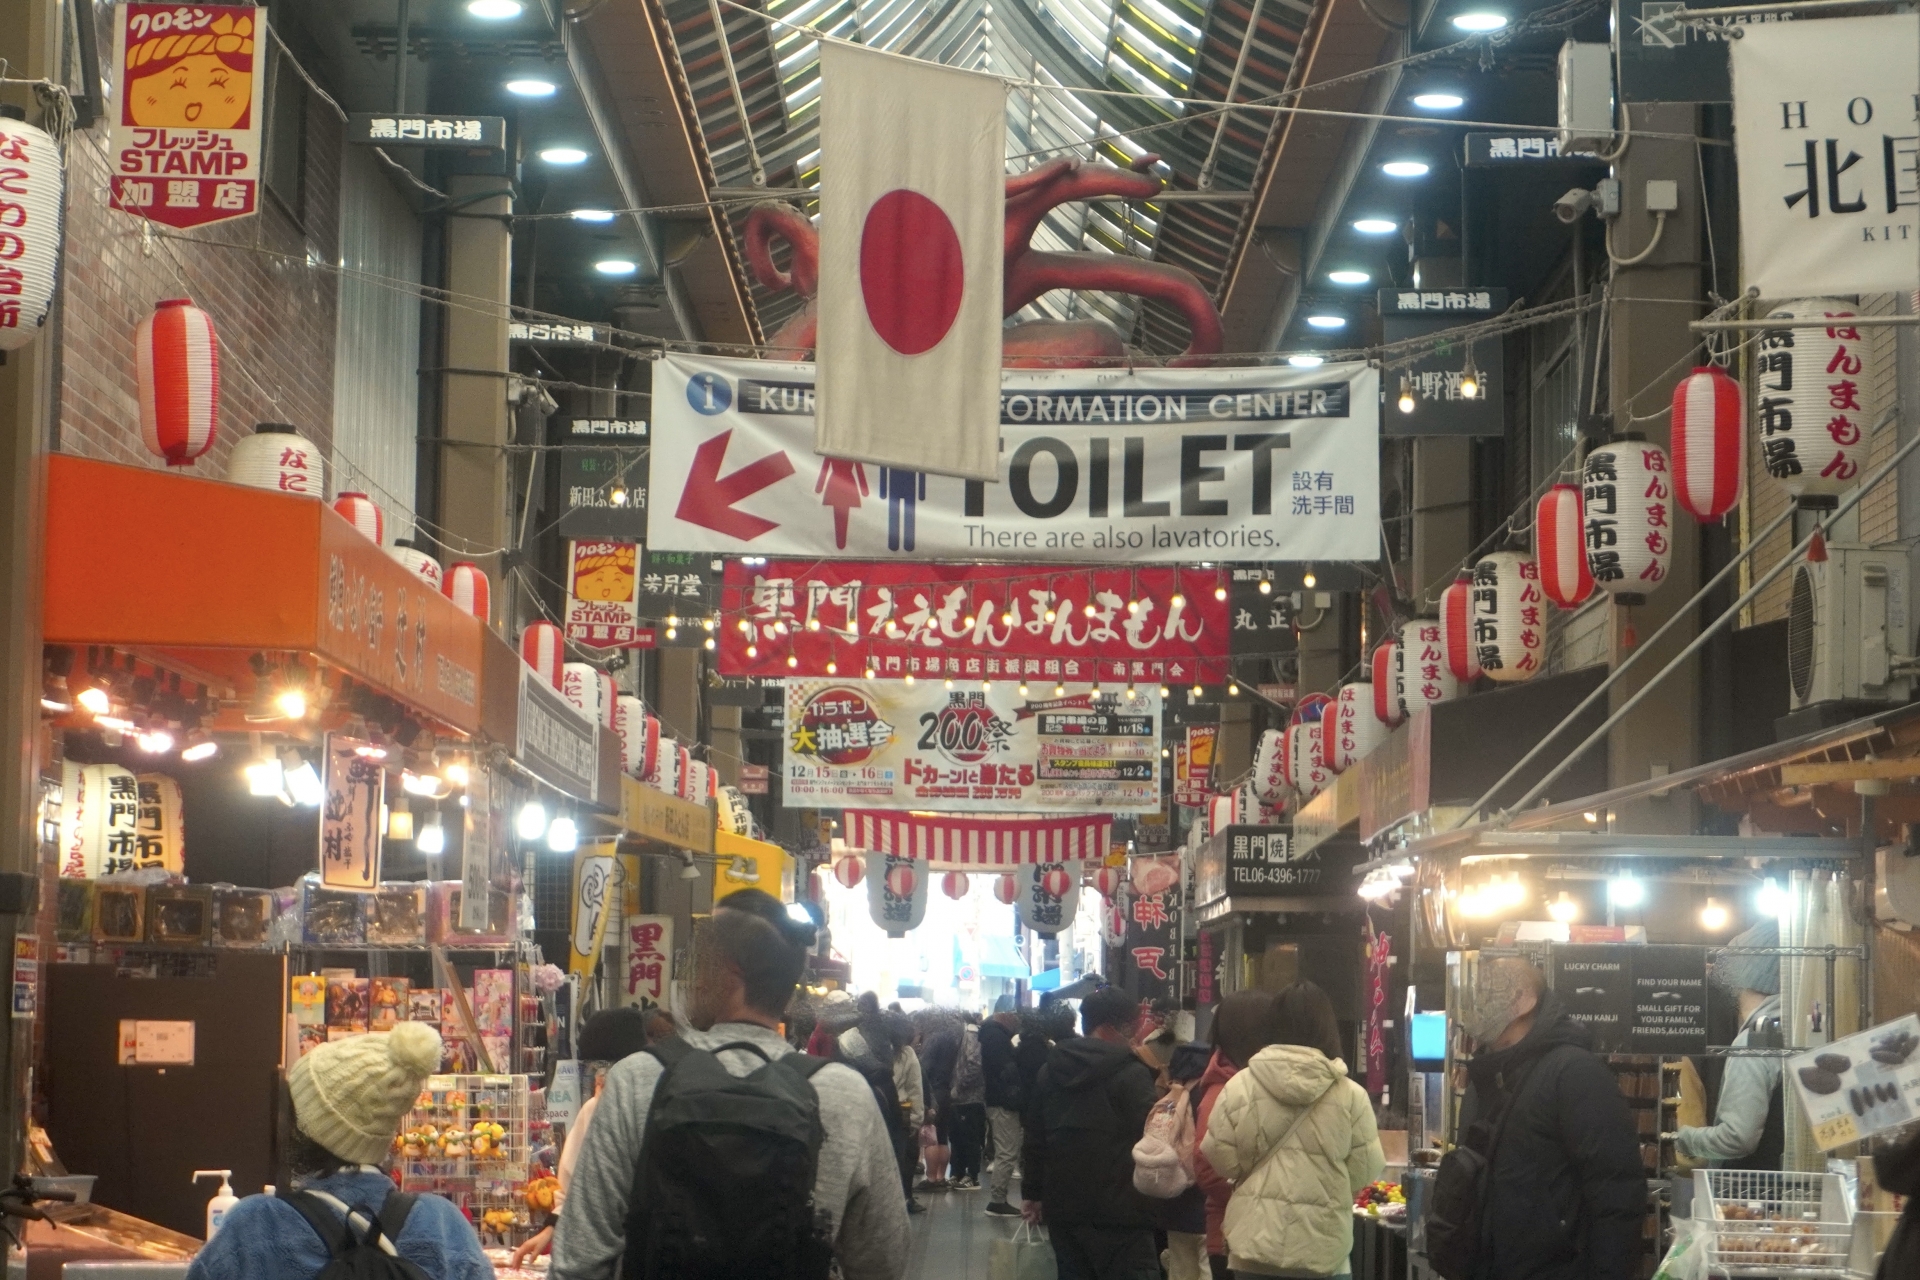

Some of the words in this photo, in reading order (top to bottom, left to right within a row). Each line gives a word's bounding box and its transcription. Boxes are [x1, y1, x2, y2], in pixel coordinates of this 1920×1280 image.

[130, 9, 213, 38] クロモン
[133, 130, 233, 150] フレッシュ
[369, 119, 482, 140] 黒門市場
[1490, 138, 1599, 158] 黒門市
[121, 151, 248, 175] STAMP
[120, 180, 247, 209] 加盟店
[1398, 292, 1491, 309] 黒門市場
[509, 324, 594, 341] 黒門市場
[1401, 371, 1488, 400] 中野酒店
[1757, 312, 1801, 479] 黒門市場
[1821, 312, 1862, 480] ほんまもん
[1001, 395, 1187, 422] ORMATION
[1209, 389, 1328, 418] CENTER
[572, 420, 647, 434] 黒門市場
[1292, 471, 1334, 491] 設有
[1292, 495, 1354, 515] 洗手間
[1584, 452, 1624, 582] 黒門市場
[1640, 450, 1669, 582] ほんまもん
[964, 524, 1037, 549] There
[1046, 532, 1084, 549] are
[1093, 524, 1143, 549] also
[1152, 524, 1281, 549] lavatories.
[577, 545, 615, 558] クロモン
[577, 601, 624, 611] フレッシュ
[744, 574, 1204, 649] 黒門ええもんほんまもん
[1473, 558, 1503, 670] 黒門市場
[1516, 561, 1541, 671] ほんまもん
[572, 612, 631, 623] STAMP
[1234, 608, 1290, 630] 丸正
[571, 626, 631, 640] 加盟店
[866, 656, 1080, 675] 黒門市場商店街振興組合
[1113, 662, 1185, 678] 南黒門会
[1420, 626, 1442, 705] ほんまも
[949, 691, 985, 709] 黒門
[791, 719, 894, 751] 大抽選会
[917, 711, 1019, 752] 200祭
[1118, 724, 1143, 733] 11/18
[1123, 766, 1144, 776] 12/2
[101, 776, 137, 874] 黒門市場
[1233, 867, 1321, 883] TEL06-4396-1777
[628, 923, 665, 998] 黒門
[1564, 963, 1590, 971] LUCKY
[1680, 979, 1702, 987] NAME
[1594, 1014, 1618, 1022] KANJI
[1665, 1016, 1696, 1024] FAMILY,
